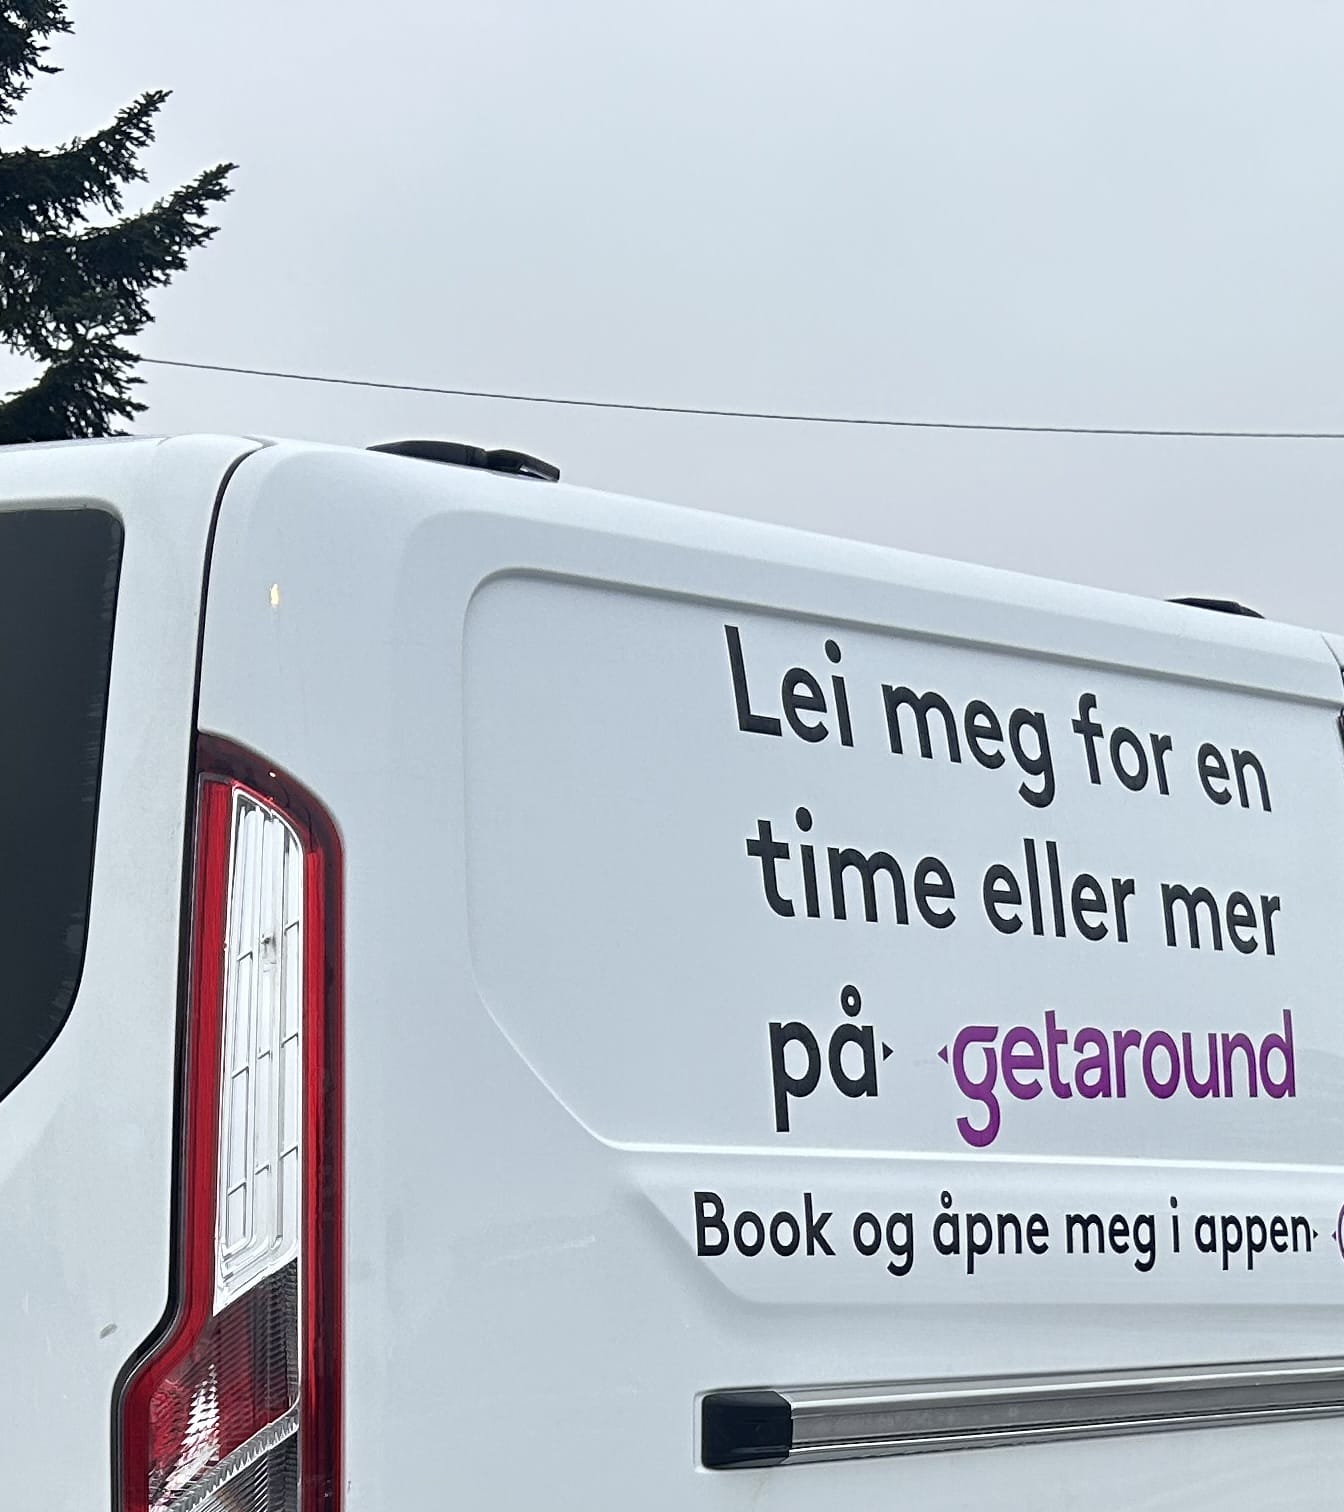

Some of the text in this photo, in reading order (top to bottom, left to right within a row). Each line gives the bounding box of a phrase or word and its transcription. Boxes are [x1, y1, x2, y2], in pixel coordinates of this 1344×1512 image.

[724, 624, 1272, 813] Lei meg for en
[745, 806, 1281, 956] time eller mer
[768, 984, 1297, 1148] på getaround
[693, 1190, 1312, 1277] Book og åpne meg i appen
